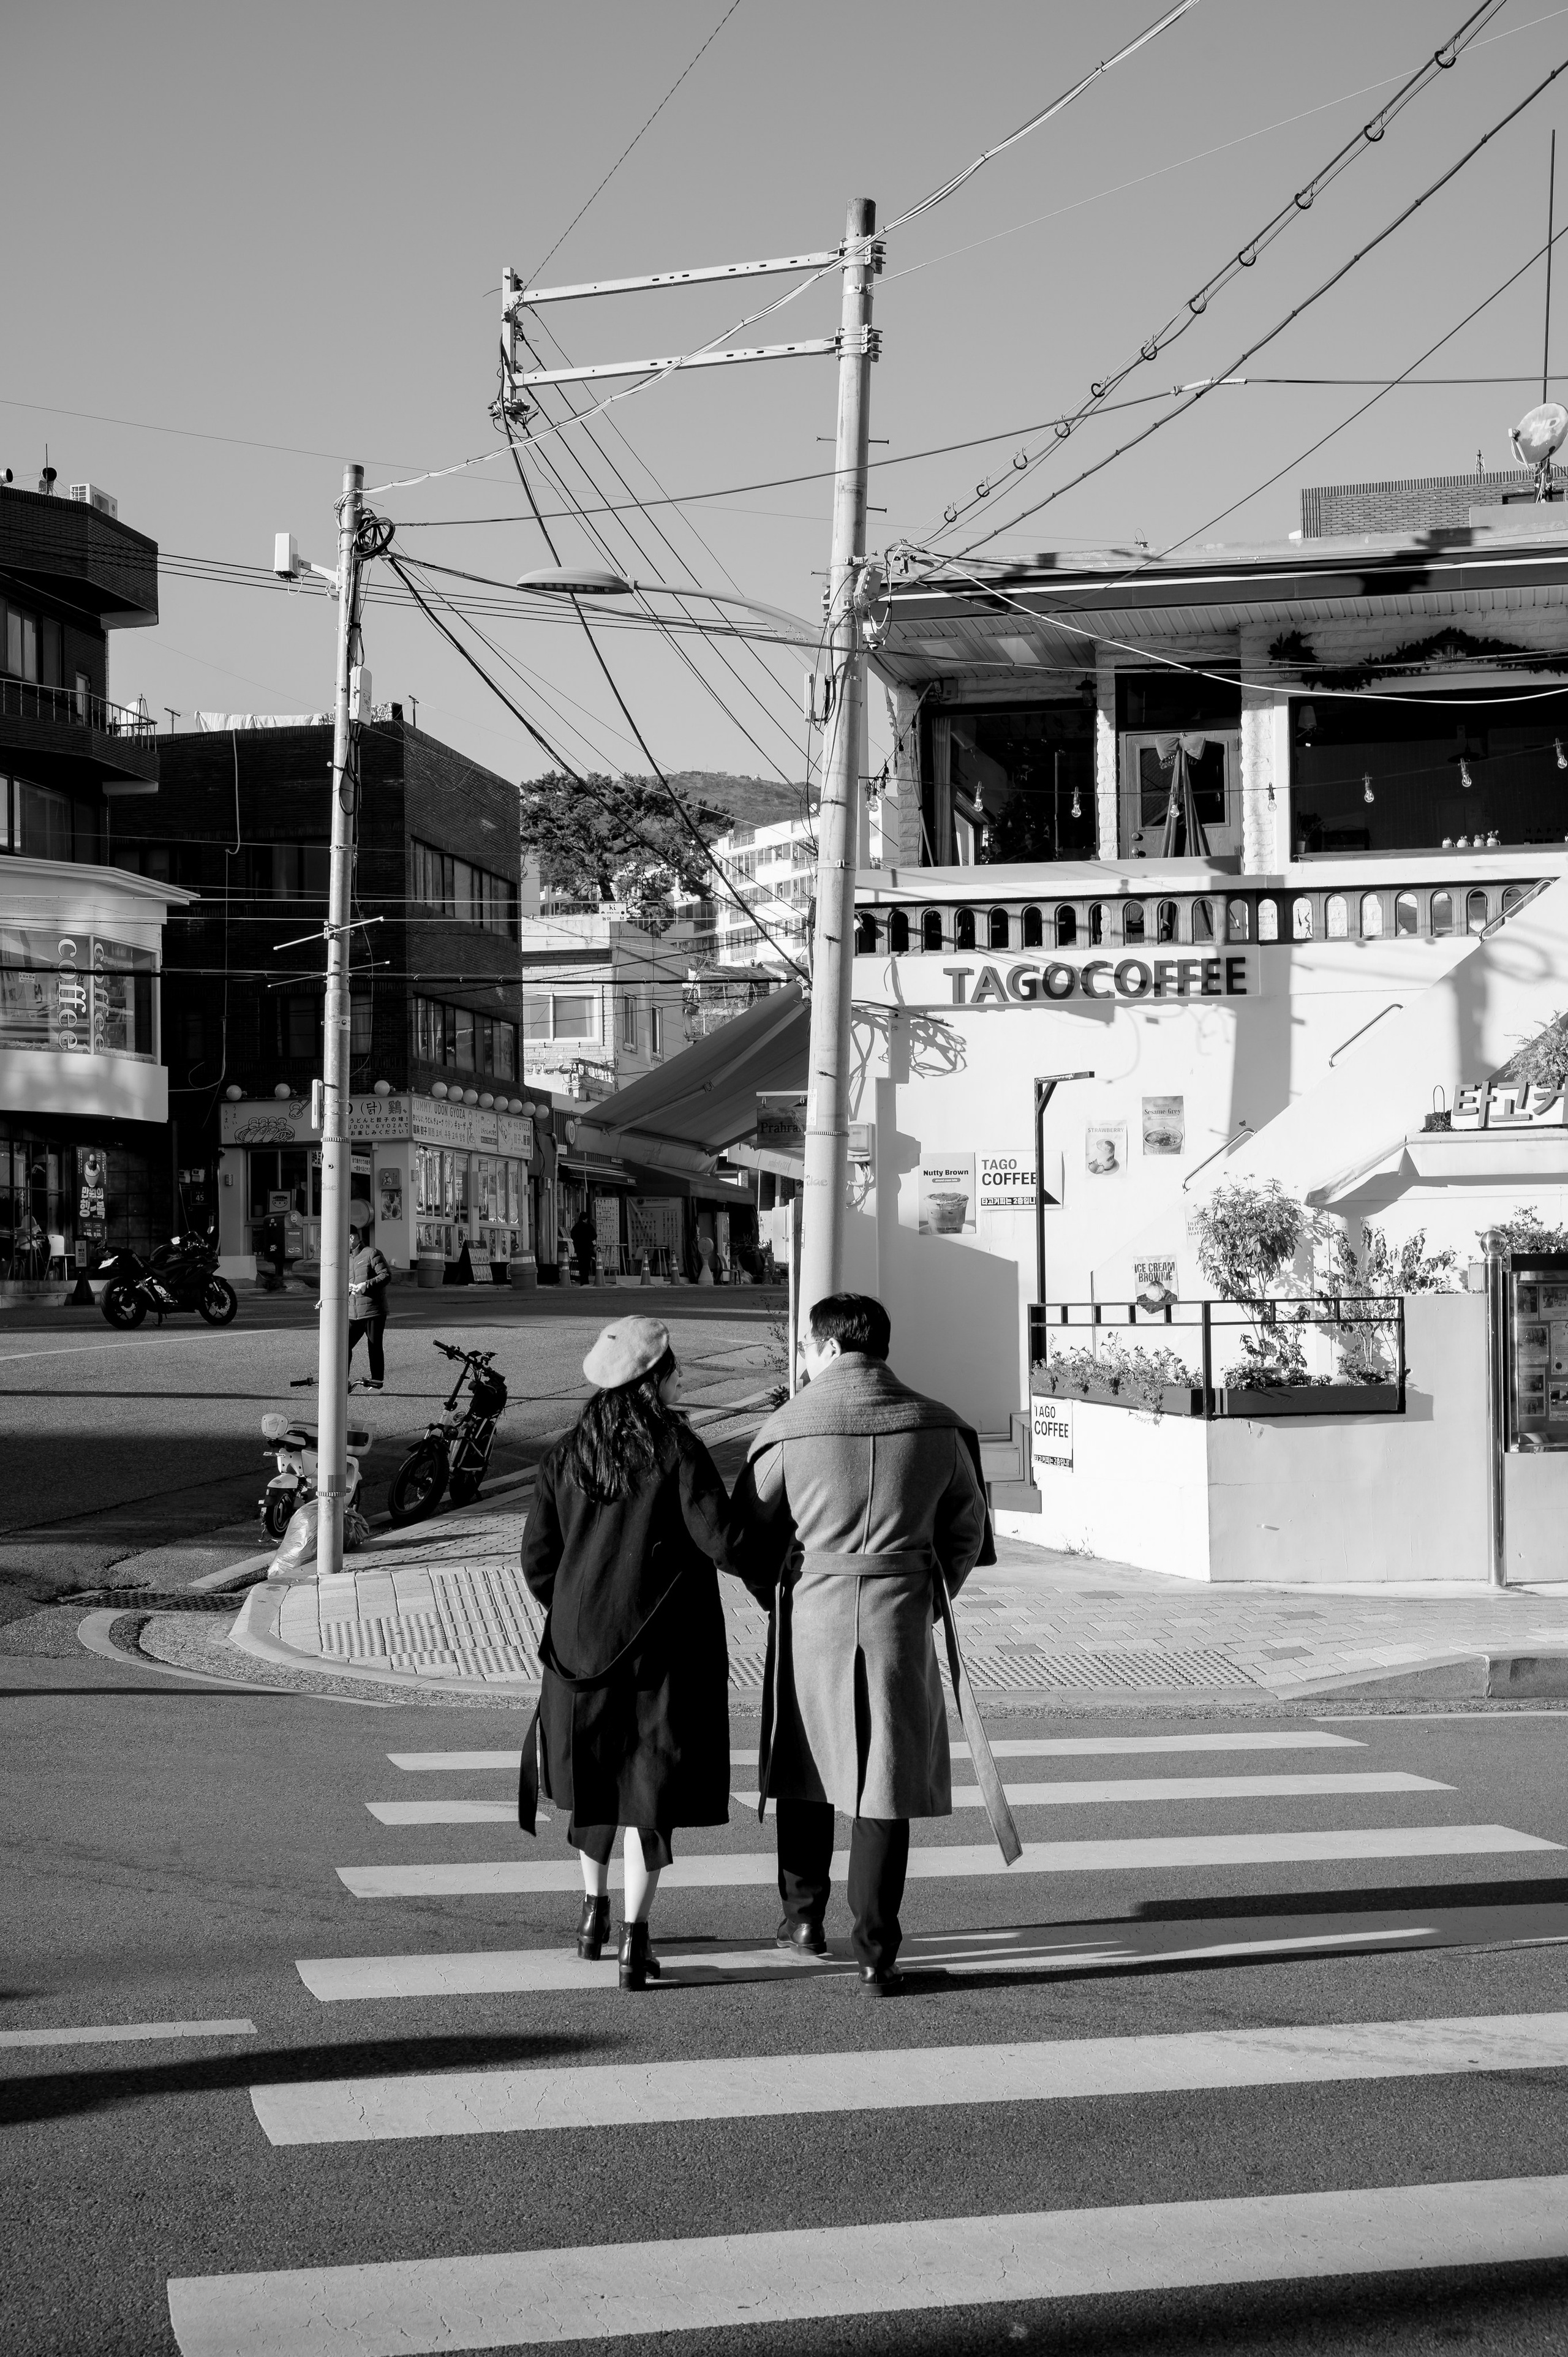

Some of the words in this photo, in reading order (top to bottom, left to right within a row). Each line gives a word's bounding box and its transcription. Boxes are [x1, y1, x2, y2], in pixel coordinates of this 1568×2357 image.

[943, 957, 1247, 1005] TAGOCOFFEE
[58, 938, 86, 1050] coffee
[94, 943, 109, 1052] coffee
[434, 1103, 448, 1116] UDON
[450, 1107, 466, 1120] GYOZA
[760, 1122, 802, 1133] Prahra
[981, 1159, 1017, 1170] TAGO
[1134, 1264, 1146, 1273] ICE
[1148, 1262, 1175, 1272] CREAM
[1138, 1272, 1173, 1282] BROWNIE
[1034, 1406, 1056, 1418] TAGO
[1034, 1420, 1069, 1438] COFFEE
